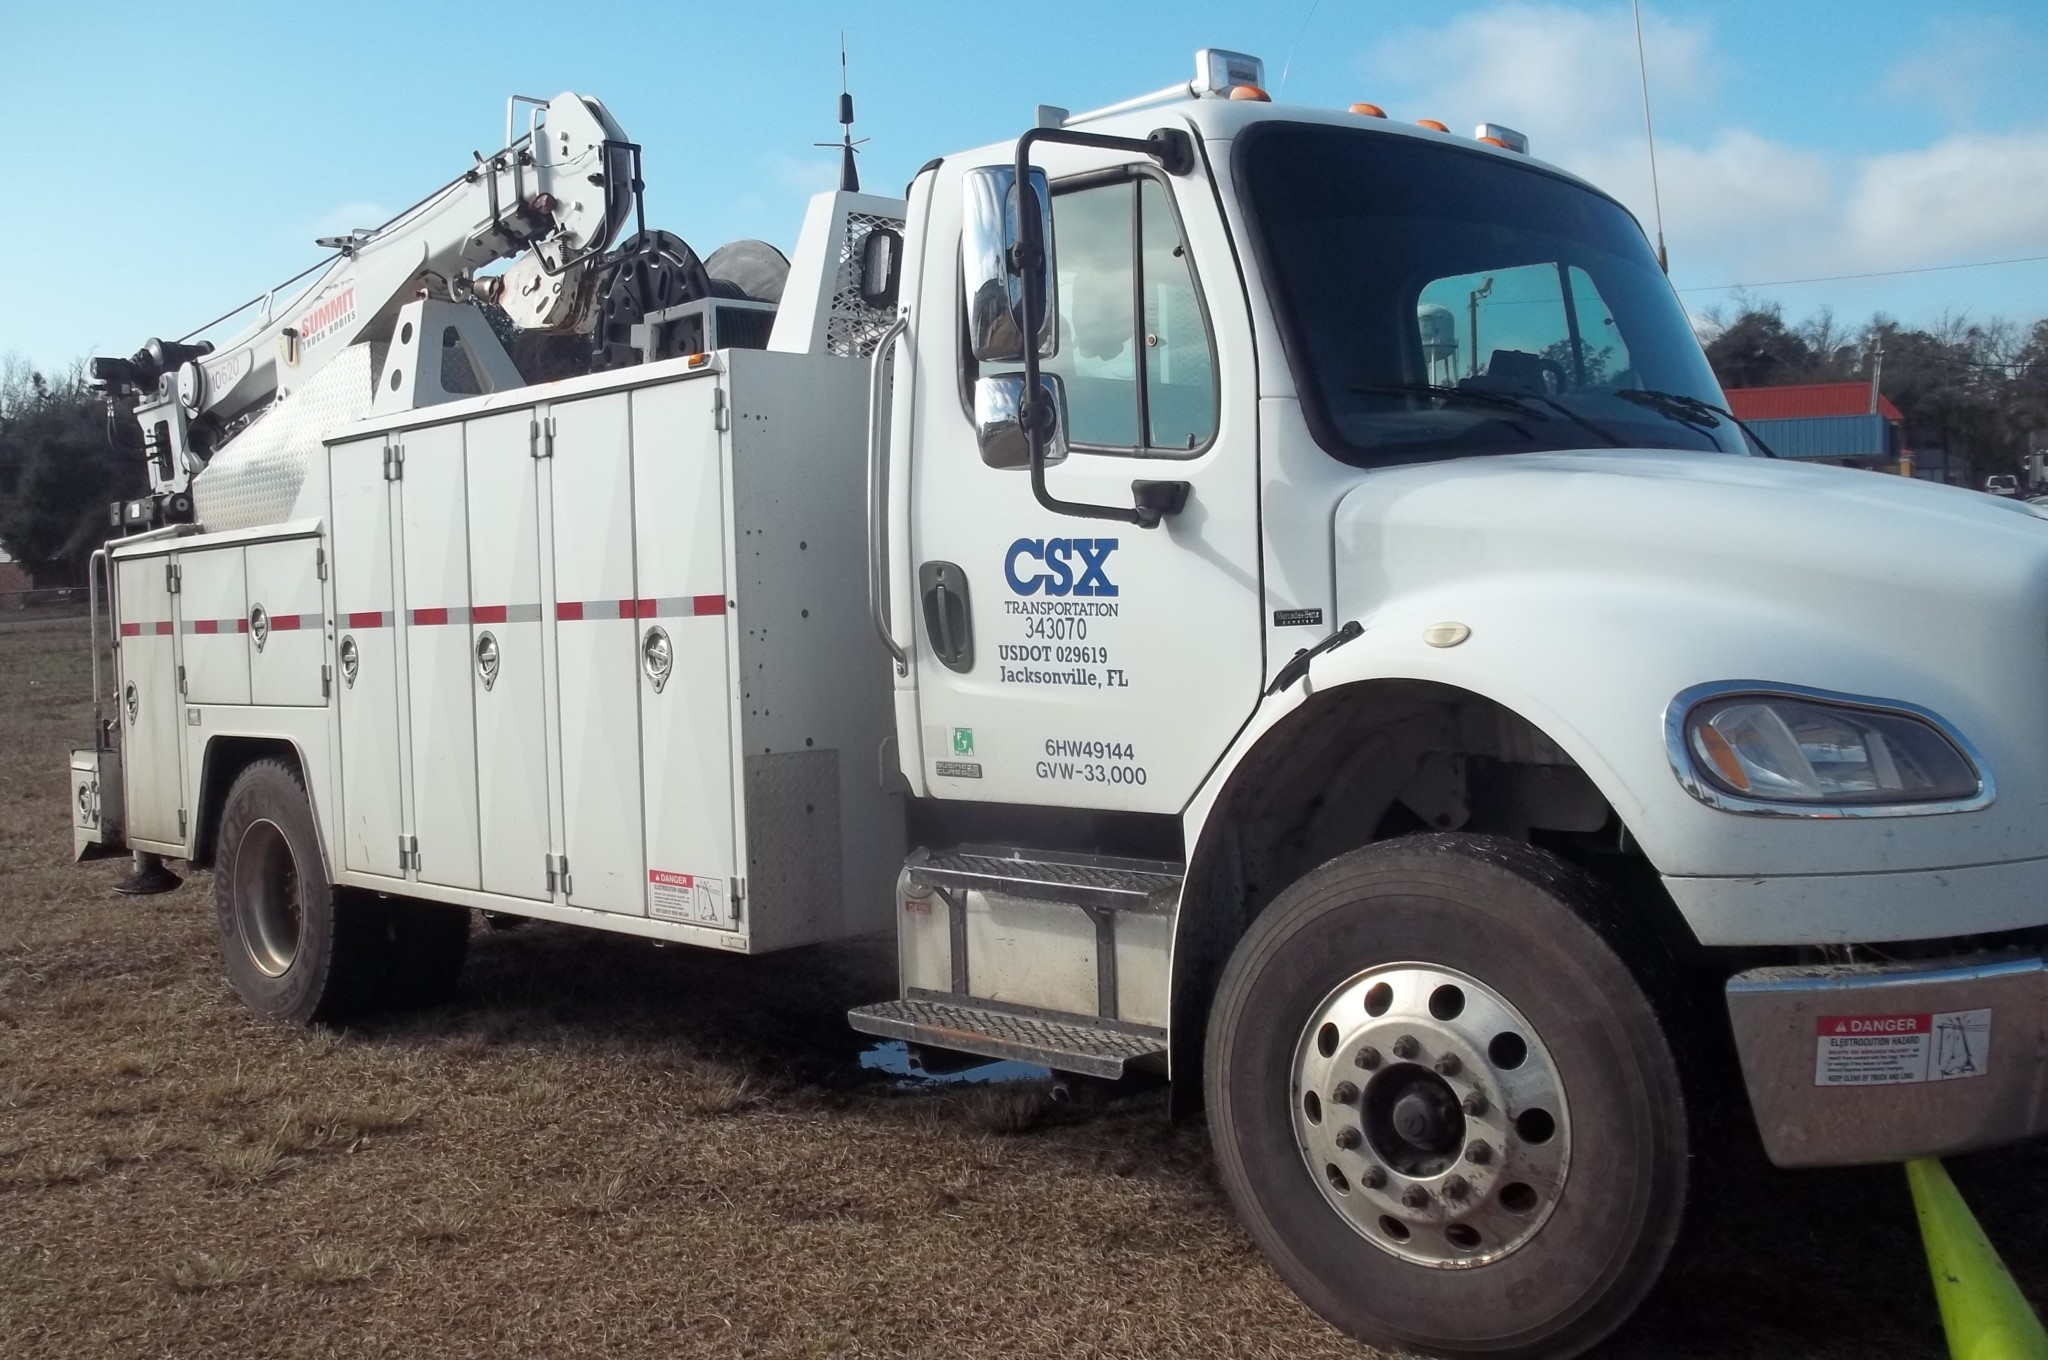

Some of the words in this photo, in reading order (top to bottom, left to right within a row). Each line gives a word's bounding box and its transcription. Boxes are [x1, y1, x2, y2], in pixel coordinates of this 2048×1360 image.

[301, 286, 355, 338] SUMMIT
[302, 329, 326, 351] TRUCK
[328, 310, 356, 335] BODIES
[212, 357, 240, 393] 10620
[1004, 537, 1119, 597] CSX
[1004, 600, 1119, 617] TRANSPORTATION
[1025, 616, 1087, 641] 343070
[998, 644, 1052, 662] USDOT
[1056, 646, 1108, 664] 029619
[1000, 665, 1102, 690] Jacksonville,
[1106, 669, 1129, 687] FL
[1045, 739, 1135, 760] 6HW49144
[1036, 761, 1147, 786] GVW-33,000
[660, 873, 687, 885] DANGER
[1851, 1018, 1917, 1033] DANGER
[1830, 1037, 1890, 1047] ELECTROCUTION
[1891, 1035, 1920, 1045] HAZARD
